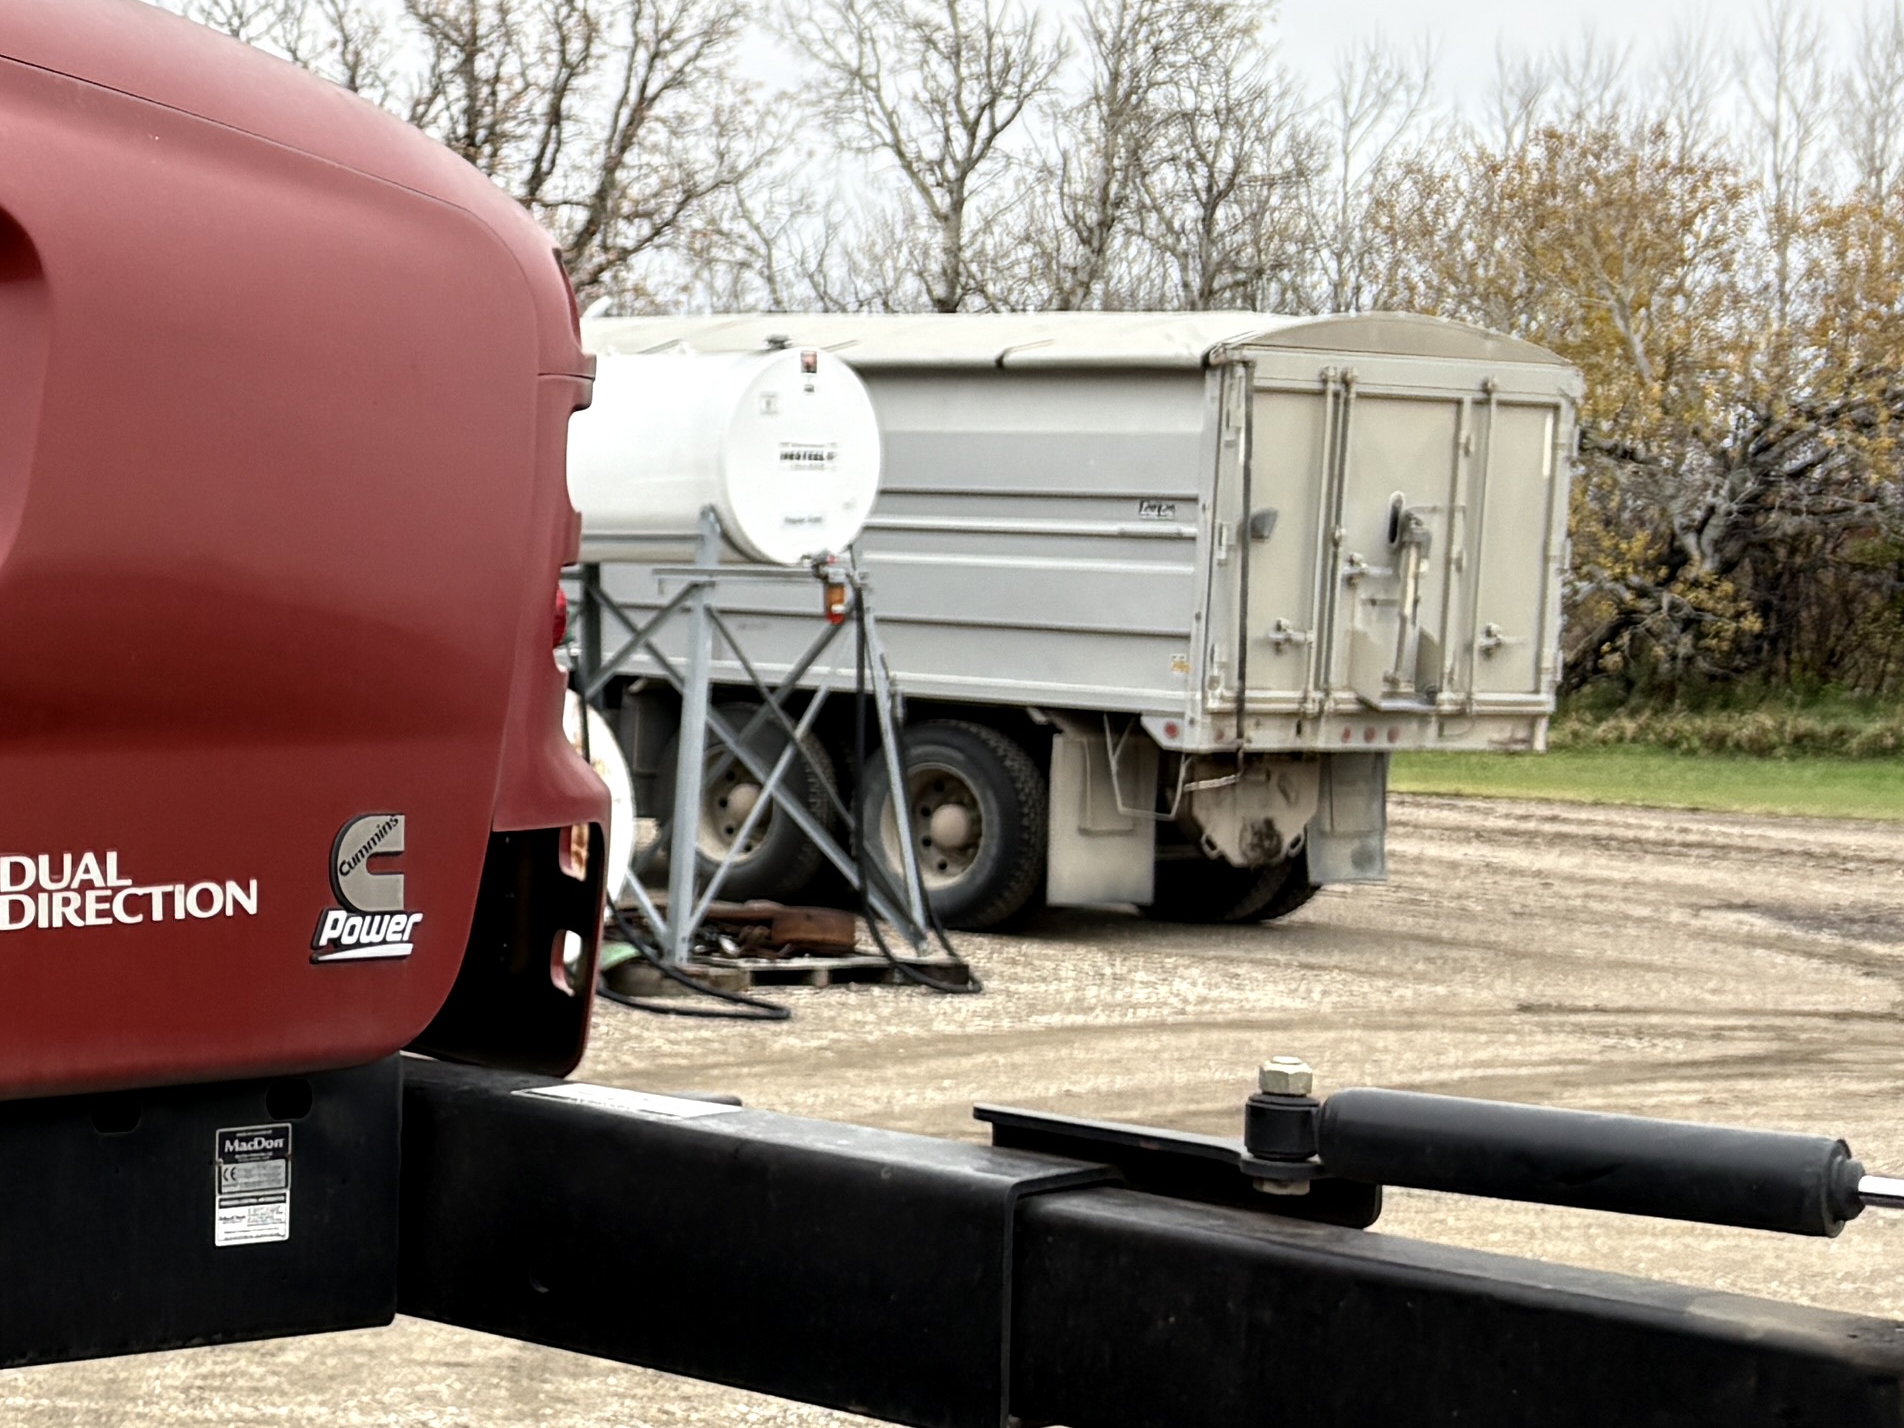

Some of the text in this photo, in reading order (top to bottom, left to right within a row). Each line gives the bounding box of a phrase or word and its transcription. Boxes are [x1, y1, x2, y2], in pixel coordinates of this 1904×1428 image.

[339, 815, 399, 876] Cummins
[0, 851, 132, 892] DUAL
[0, 879, 258, 930] DIRECTION
[319, 910, 423, 946] Power
[225, 1136, 285, 1153] MacDon
